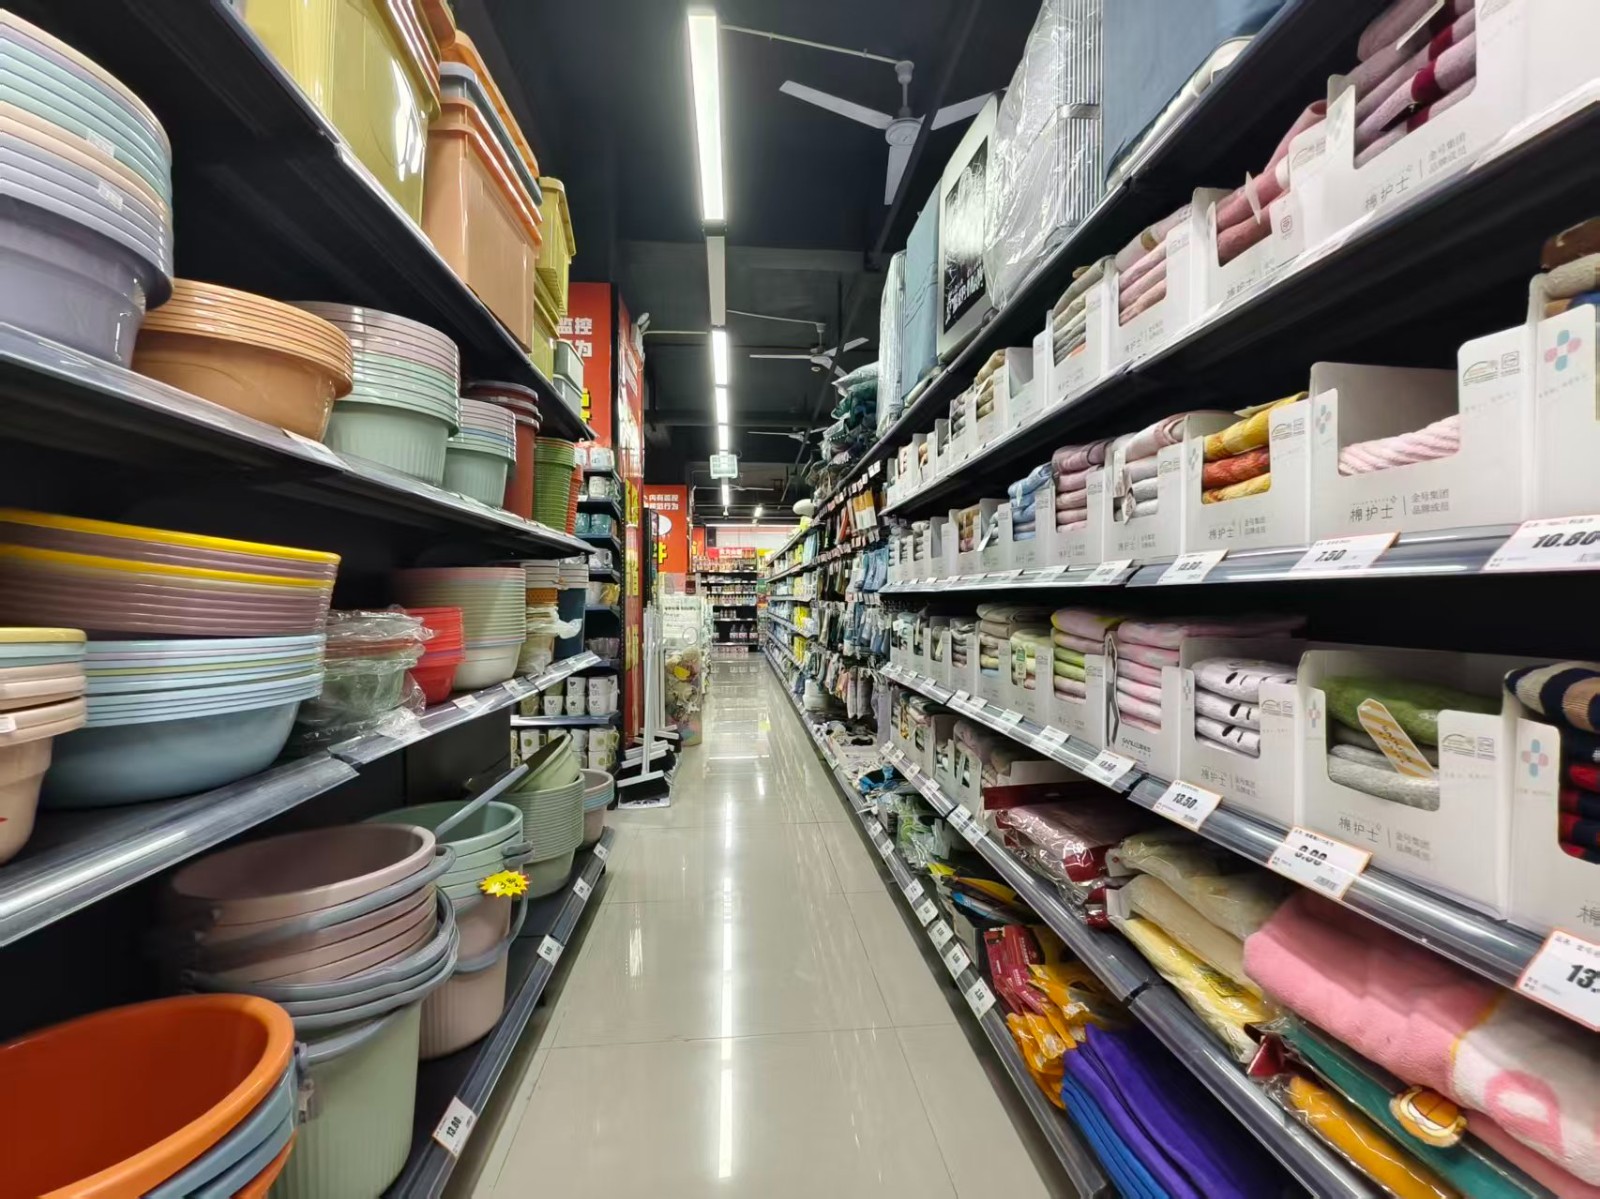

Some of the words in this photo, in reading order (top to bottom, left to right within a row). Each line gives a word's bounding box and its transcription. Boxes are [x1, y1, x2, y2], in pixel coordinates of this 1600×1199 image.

[1350, 504, 1394, 522] 棉护士
[1172, 792, 1199, 810] 13.50
